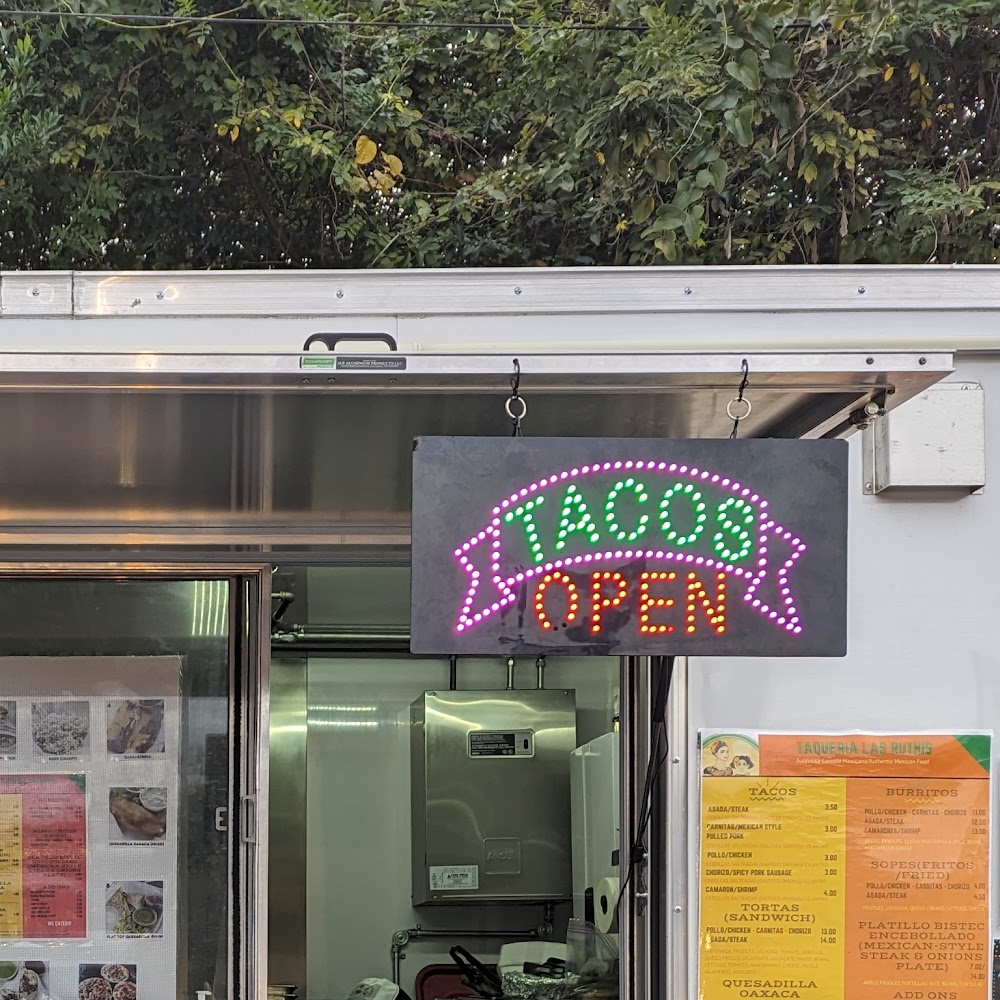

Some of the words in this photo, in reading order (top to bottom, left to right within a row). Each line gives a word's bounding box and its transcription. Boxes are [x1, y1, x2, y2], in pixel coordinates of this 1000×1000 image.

[503, 477, 756, 563] TACOS
[535, 571, 728, 634] OPEN
[796, 741, 857, 755] TAQUERIA
[862, 742, 886, 755] LAS
[891, 742, 932, 756] RUTHIS
[748, 788, 797, 796] TACOS
[886, 788, 958, 797] BURRITOS
[871, 860, 974, 870] SOPES(FRITOS
[895, 871, 950, 881] /FRIED)
[724, 913, 816, 924] (SANDWICH)
[934, 922, 985, 930] BISTEC
[869, 932, 975, 940] ENCEBOLLADO
[858, 941, 984, 951] (MEXICAN-STYLE
[927, 952, 983, 960] ONIONS
[896, 963, 949, 972] PLATE)
[722, 980, 818, 988] QUESADILLA
[740, 990, 800, 998] OAXACA
[893, 991, 924, 999] ADD
